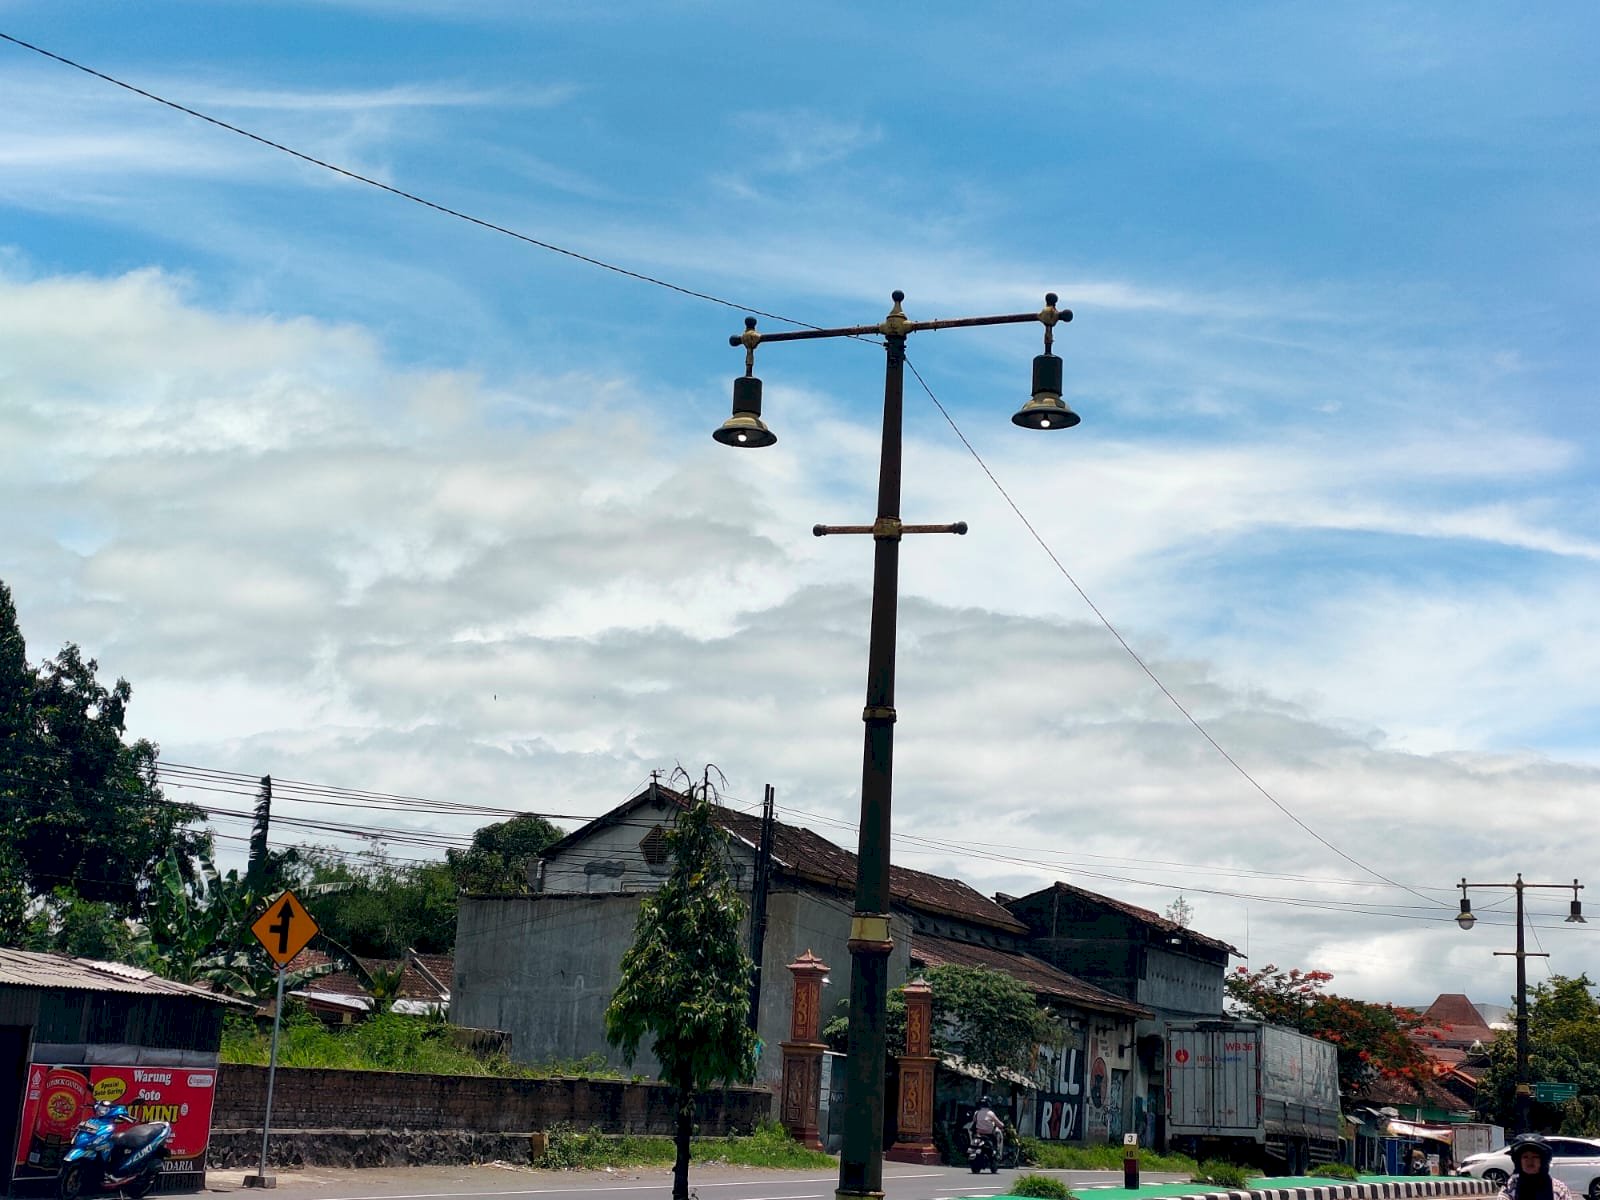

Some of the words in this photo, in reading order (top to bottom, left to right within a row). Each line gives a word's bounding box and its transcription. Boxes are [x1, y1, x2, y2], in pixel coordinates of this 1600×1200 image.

[133, 1069, 171, 1085] Warung
[138, 1089, 161, 1101] Soto
[142, 1105, 179, 1122] MINI
[1128, 1135, 1133, 1143] 3
[161, 1160, 193, 1171] NDARIA
